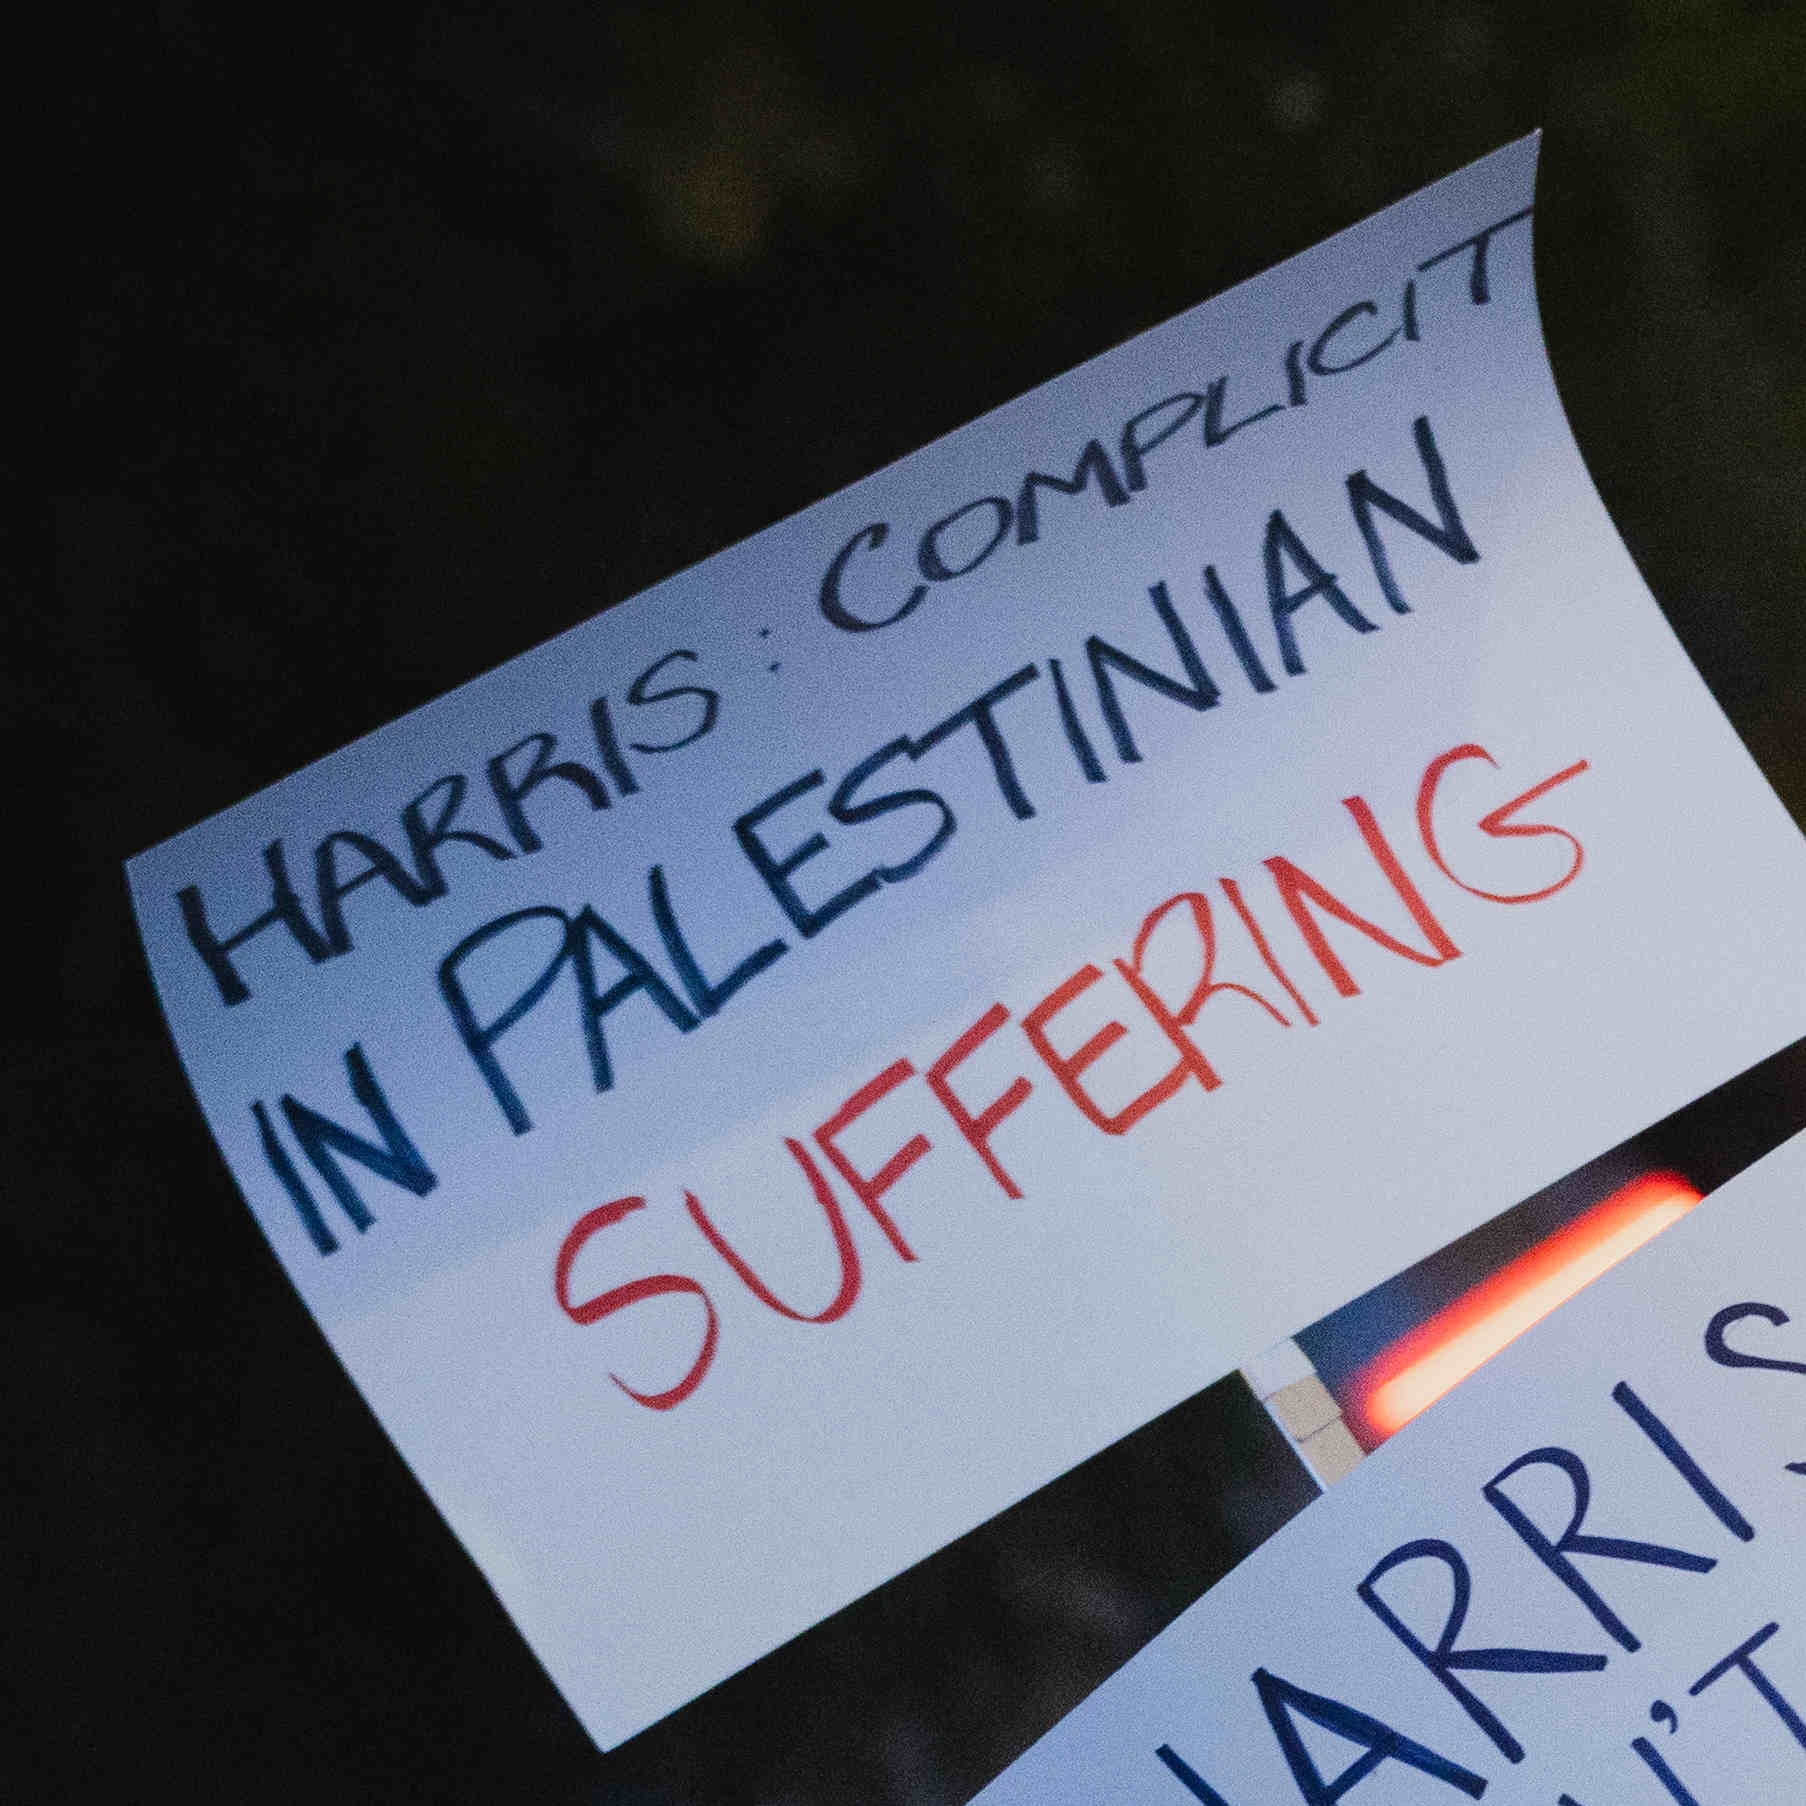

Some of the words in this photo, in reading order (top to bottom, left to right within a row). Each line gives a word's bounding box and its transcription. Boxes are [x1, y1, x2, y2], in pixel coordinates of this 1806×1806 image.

[818, 204, 1533, 634] COMPLICIT
[250, 1041, 439, 1256] IN
[435, 414, 1482, 1138] PALESTINIAN
[553, 741, 1591, 1411] SUFFERING
